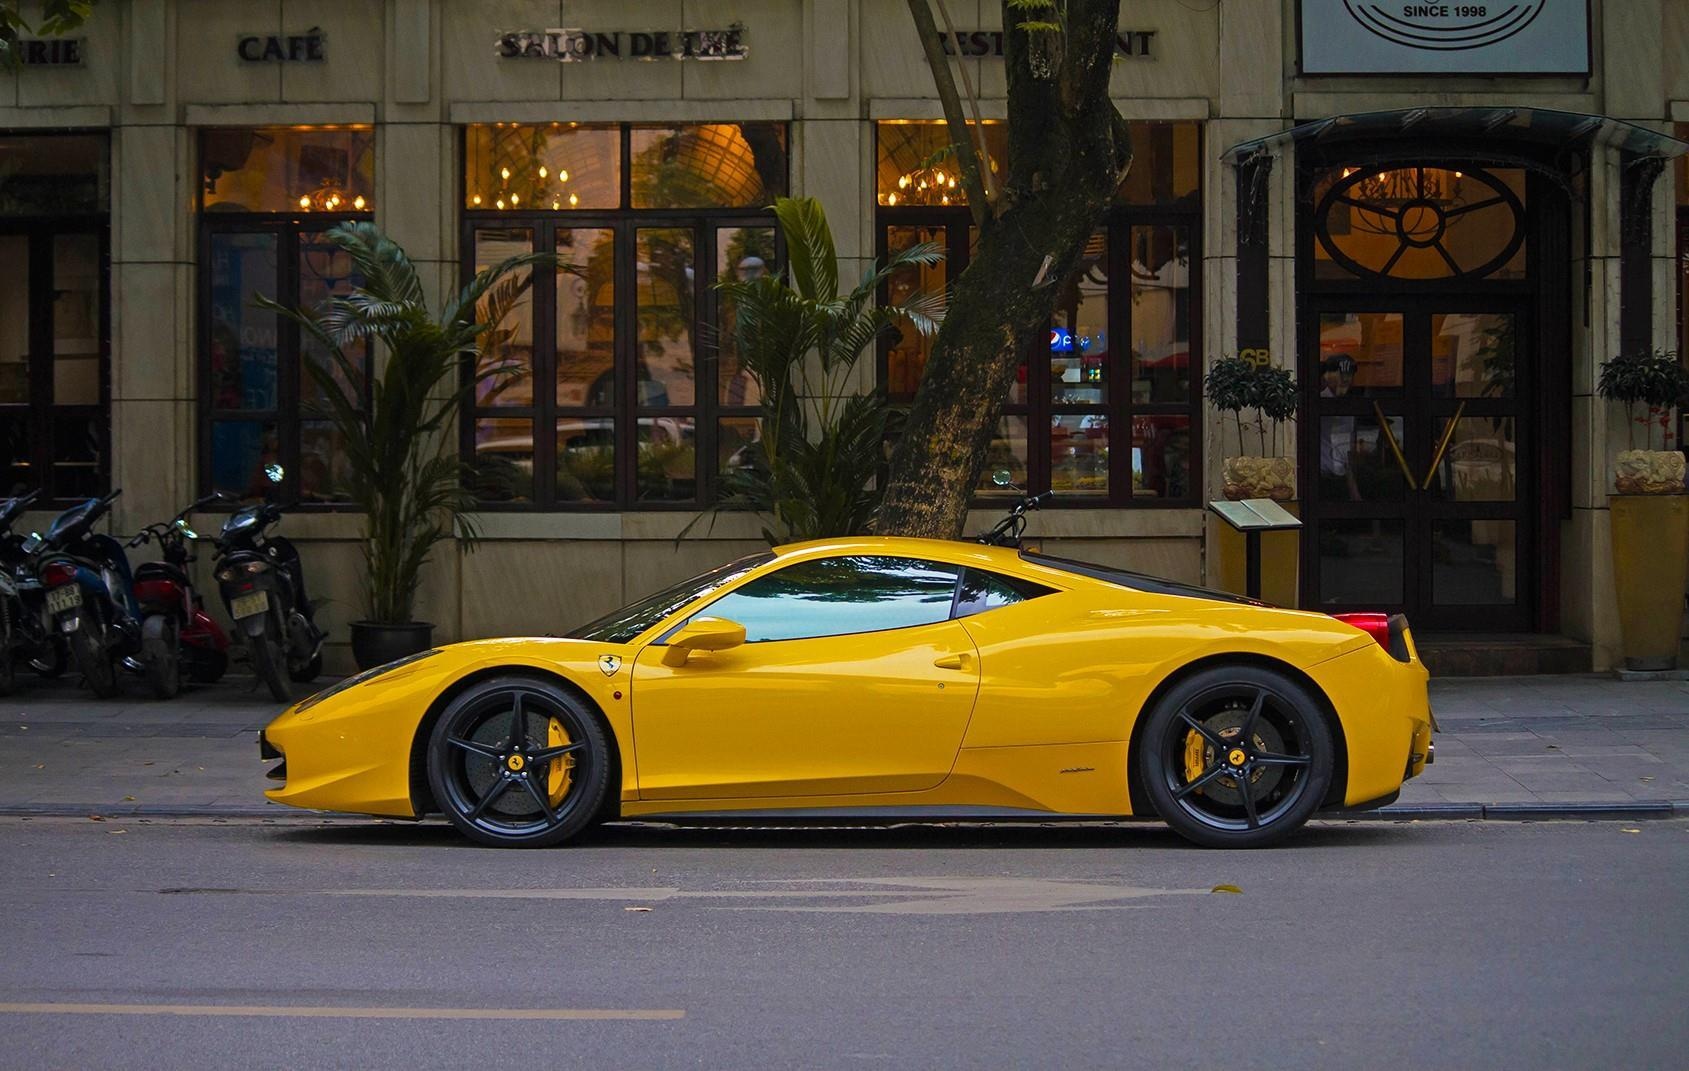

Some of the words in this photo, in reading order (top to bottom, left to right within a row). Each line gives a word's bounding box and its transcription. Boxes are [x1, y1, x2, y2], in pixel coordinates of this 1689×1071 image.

[1404, 6, 1448, 17] SINCE
[1454, 6, 1487, 17] 1998
[238, 26, 323, 61] CAFÉ
[499, 30, 619, 58] SALON
[630, 31, 672, 56] DE
